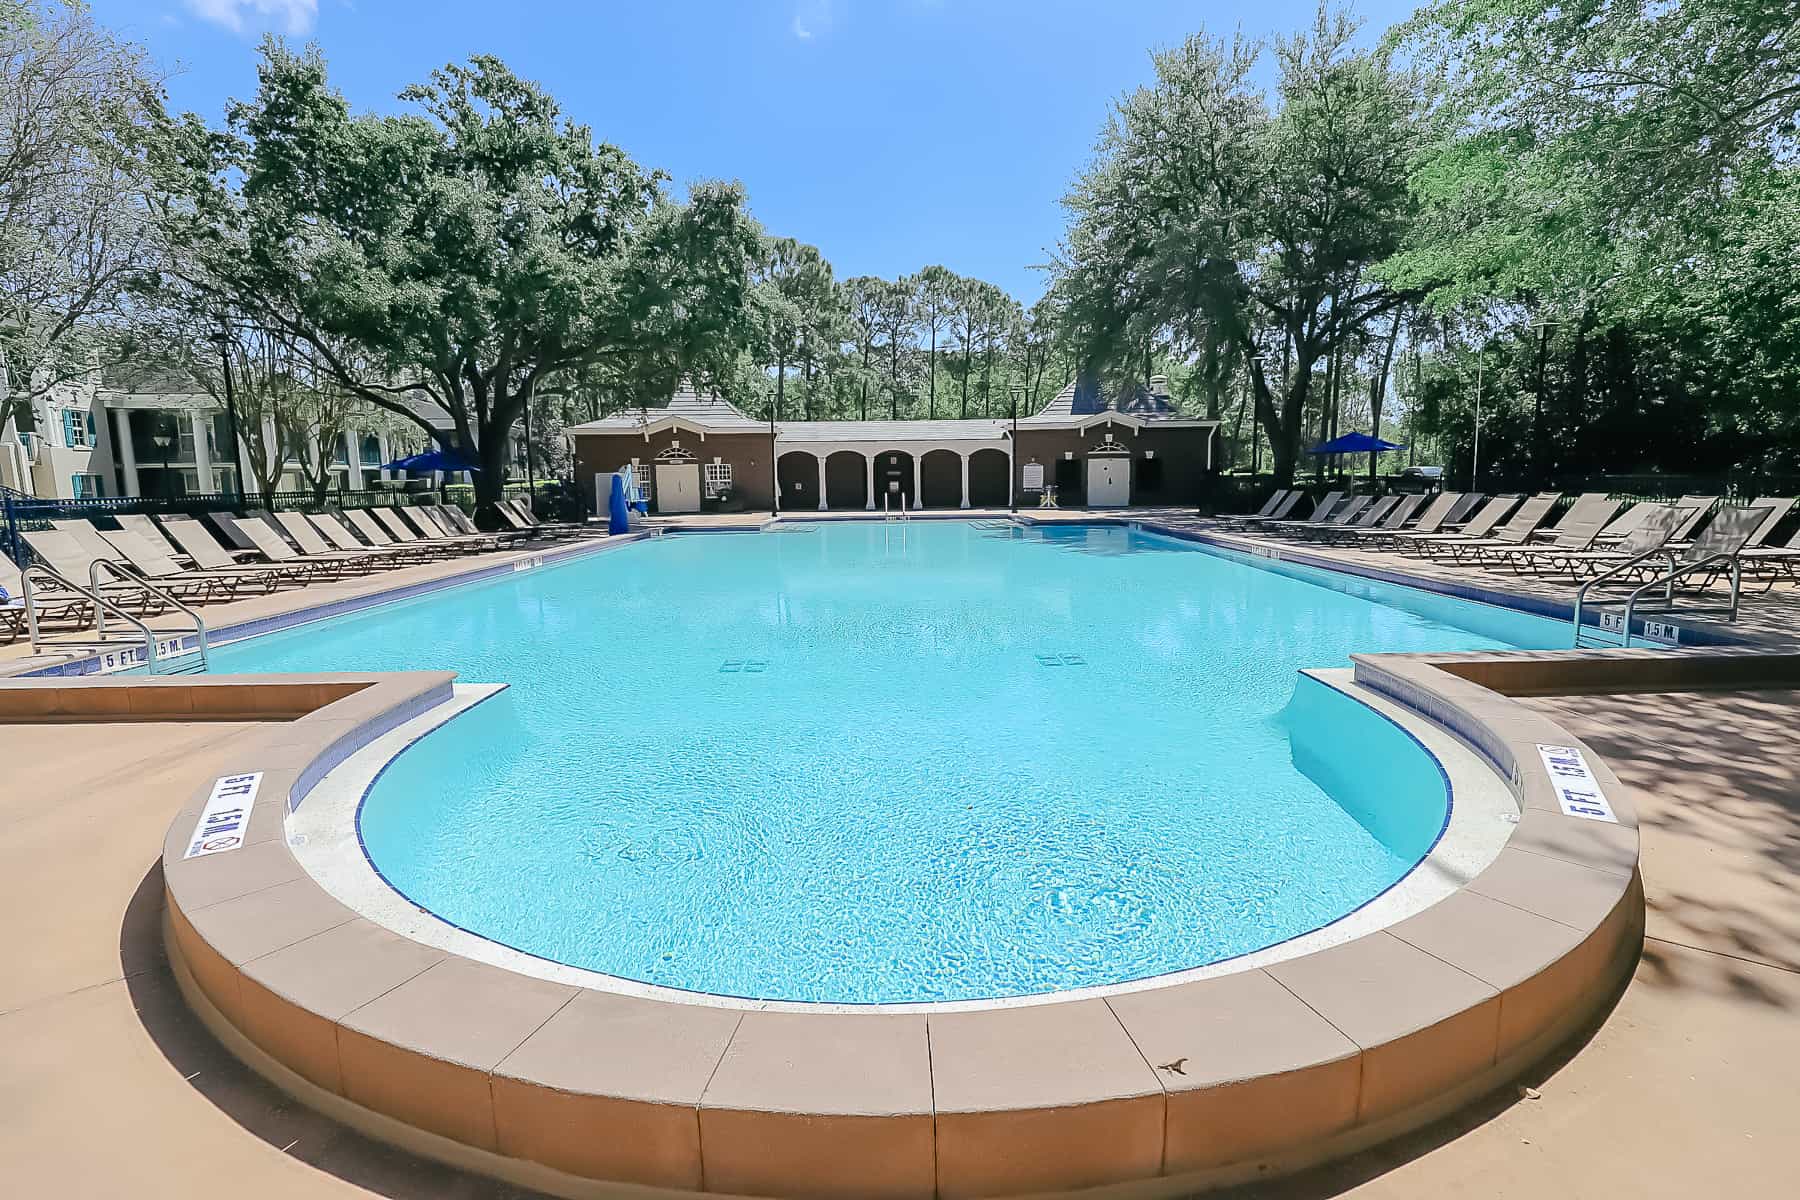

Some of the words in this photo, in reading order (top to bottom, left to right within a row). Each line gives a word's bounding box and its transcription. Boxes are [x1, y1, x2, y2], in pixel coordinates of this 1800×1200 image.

[106, 654, 114, 667] 5
[120, 649, 134, 665] FT
[225, 776, 254, 784] 5
[1570, 805, 1605, 816] 5
